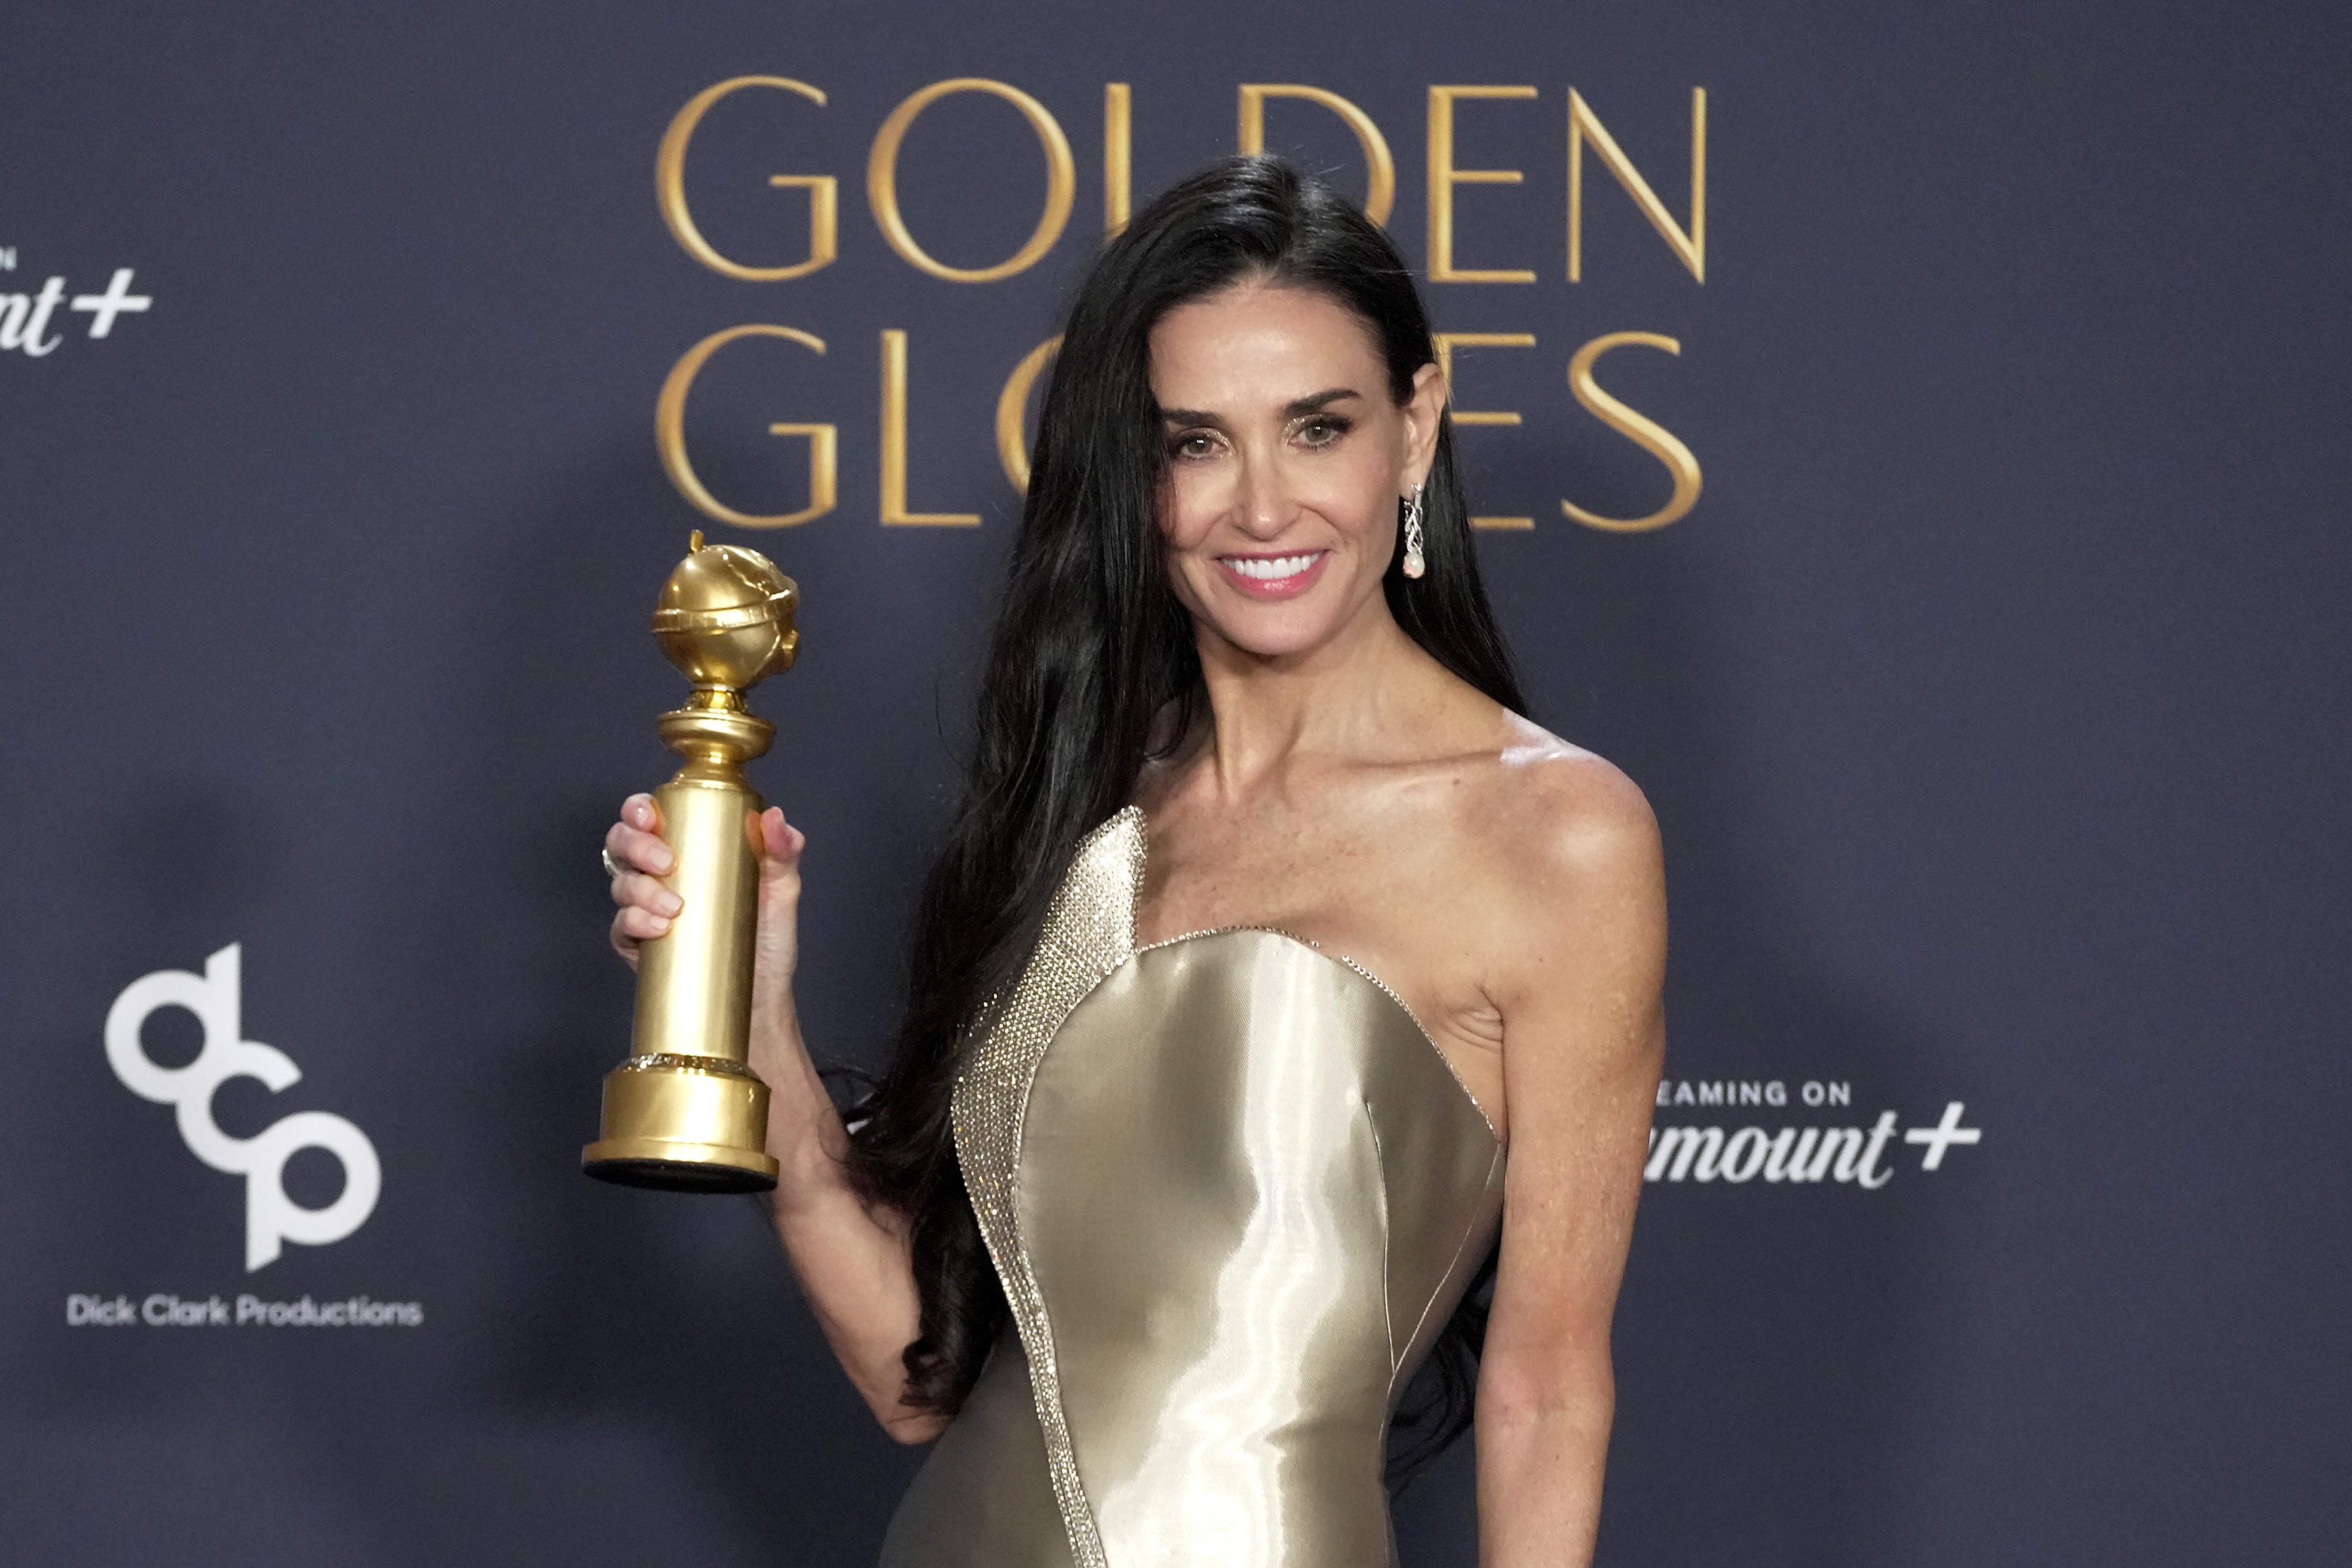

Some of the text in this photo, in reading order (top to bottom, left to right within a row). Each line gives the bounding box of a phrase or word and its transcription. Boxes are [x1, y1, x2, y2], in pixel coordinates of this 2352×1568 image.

[657, 75, 1707, 283] GOLDEN
[656, 325, 1702, 532] GLES
[1801, 1081, 1851, 1106] ON
[1644, 1101, 1982, 1190] mount+
[66, 1294, 424, 1326] Dick Clark Productions
